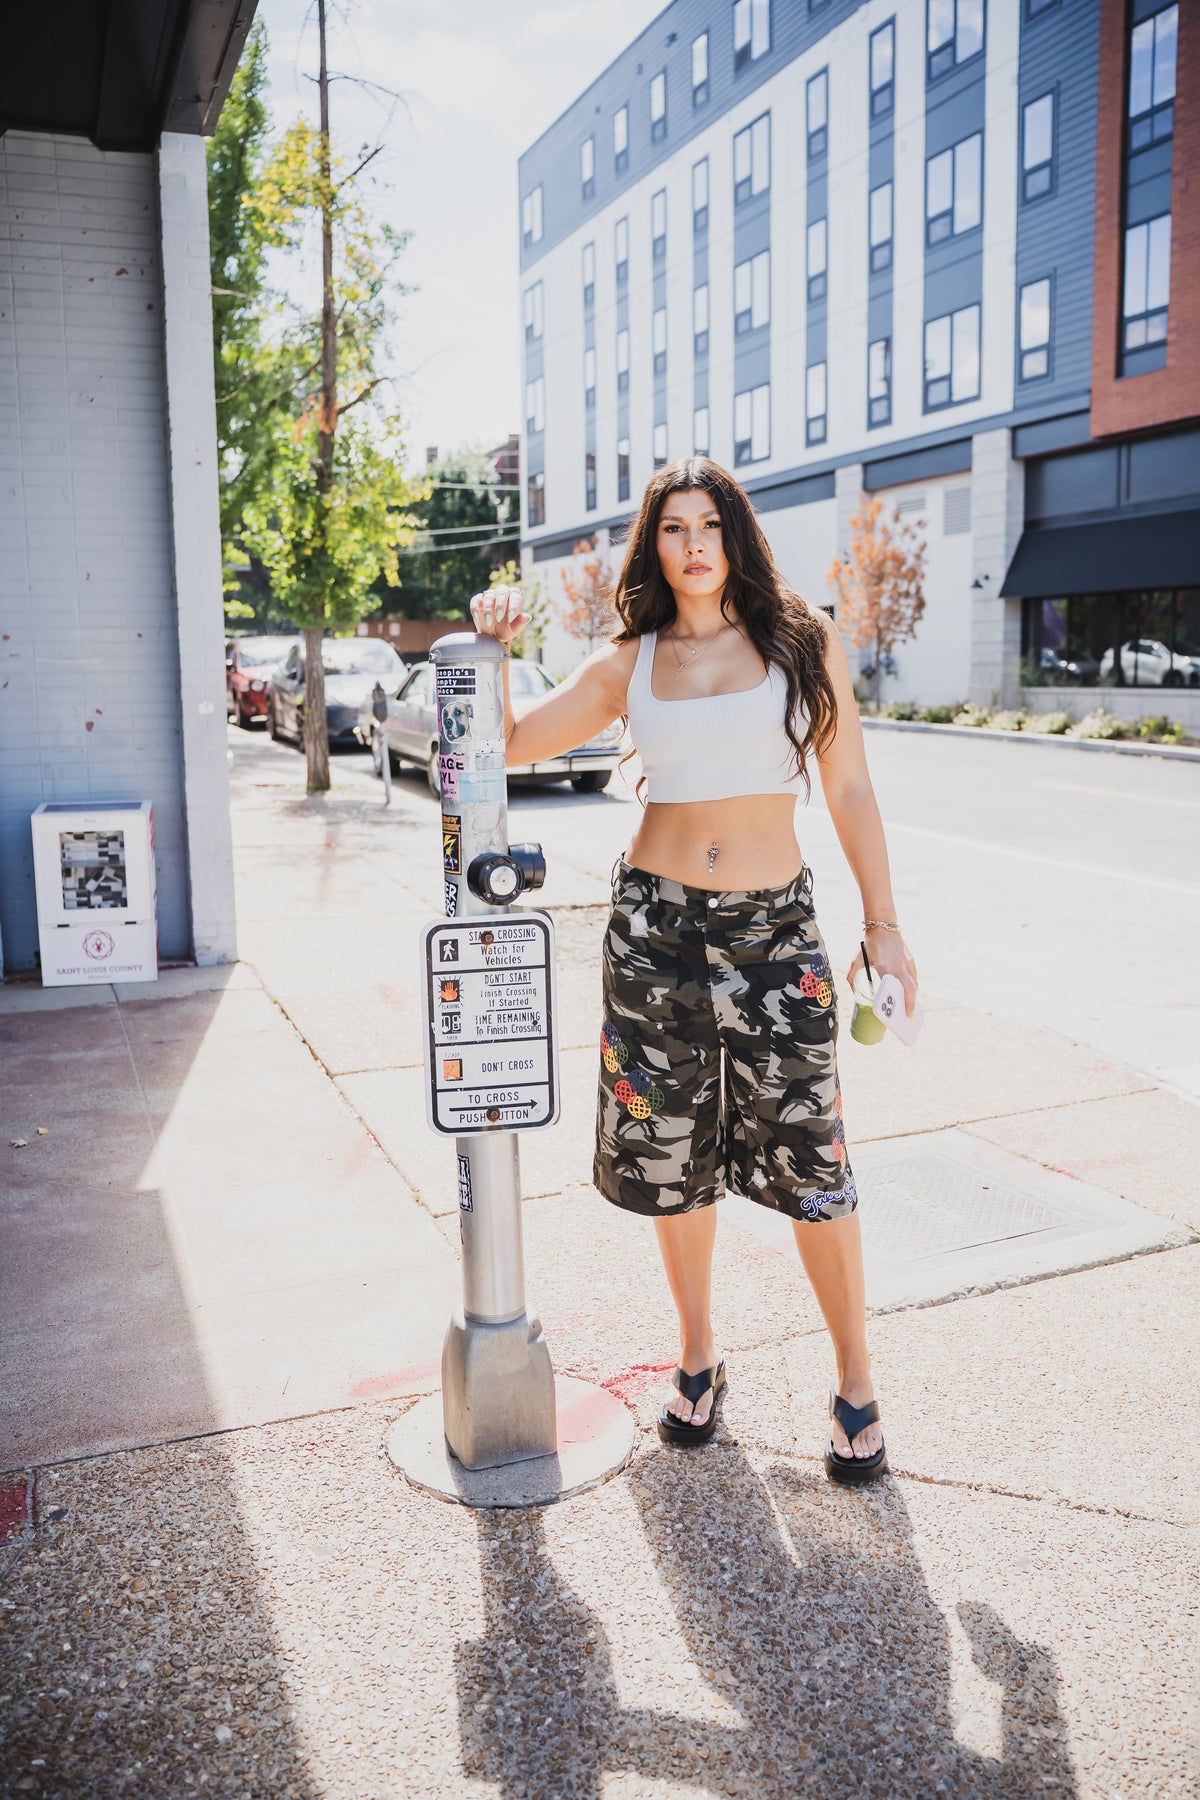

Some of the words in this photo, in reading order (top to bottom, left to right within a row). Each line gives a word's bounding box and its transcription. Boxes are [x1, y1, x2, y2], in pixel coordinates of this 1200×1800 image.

[498, 928, 536, 939] CROSSING
[481, 945, 507, 955] Watch
[513, 944, 525, 953] for
[485, 955, 522, 965] Vehicles
[509, 972, 532, 982] START
[506, 988, 537, 997] Crossing
[499, 998, 529, 1007] Started
[497, 1012, 541, 1024] REMAINING
[487, 1025, 508, 1035] Finish
[511, 1024, 542, 1034] Crossing
[482, 1062, 504, 1072] DON'T
[509, 1060, 534, 1070] CROSS
[468, 1094, 481, 1104] TO
[486, 1092, 519, 1103] CROSS
[460, 1113, 486, 1123] PUSH
[489, 1110, 529, 1121] UTTON
[800, 1191, 844, 1217] Take
